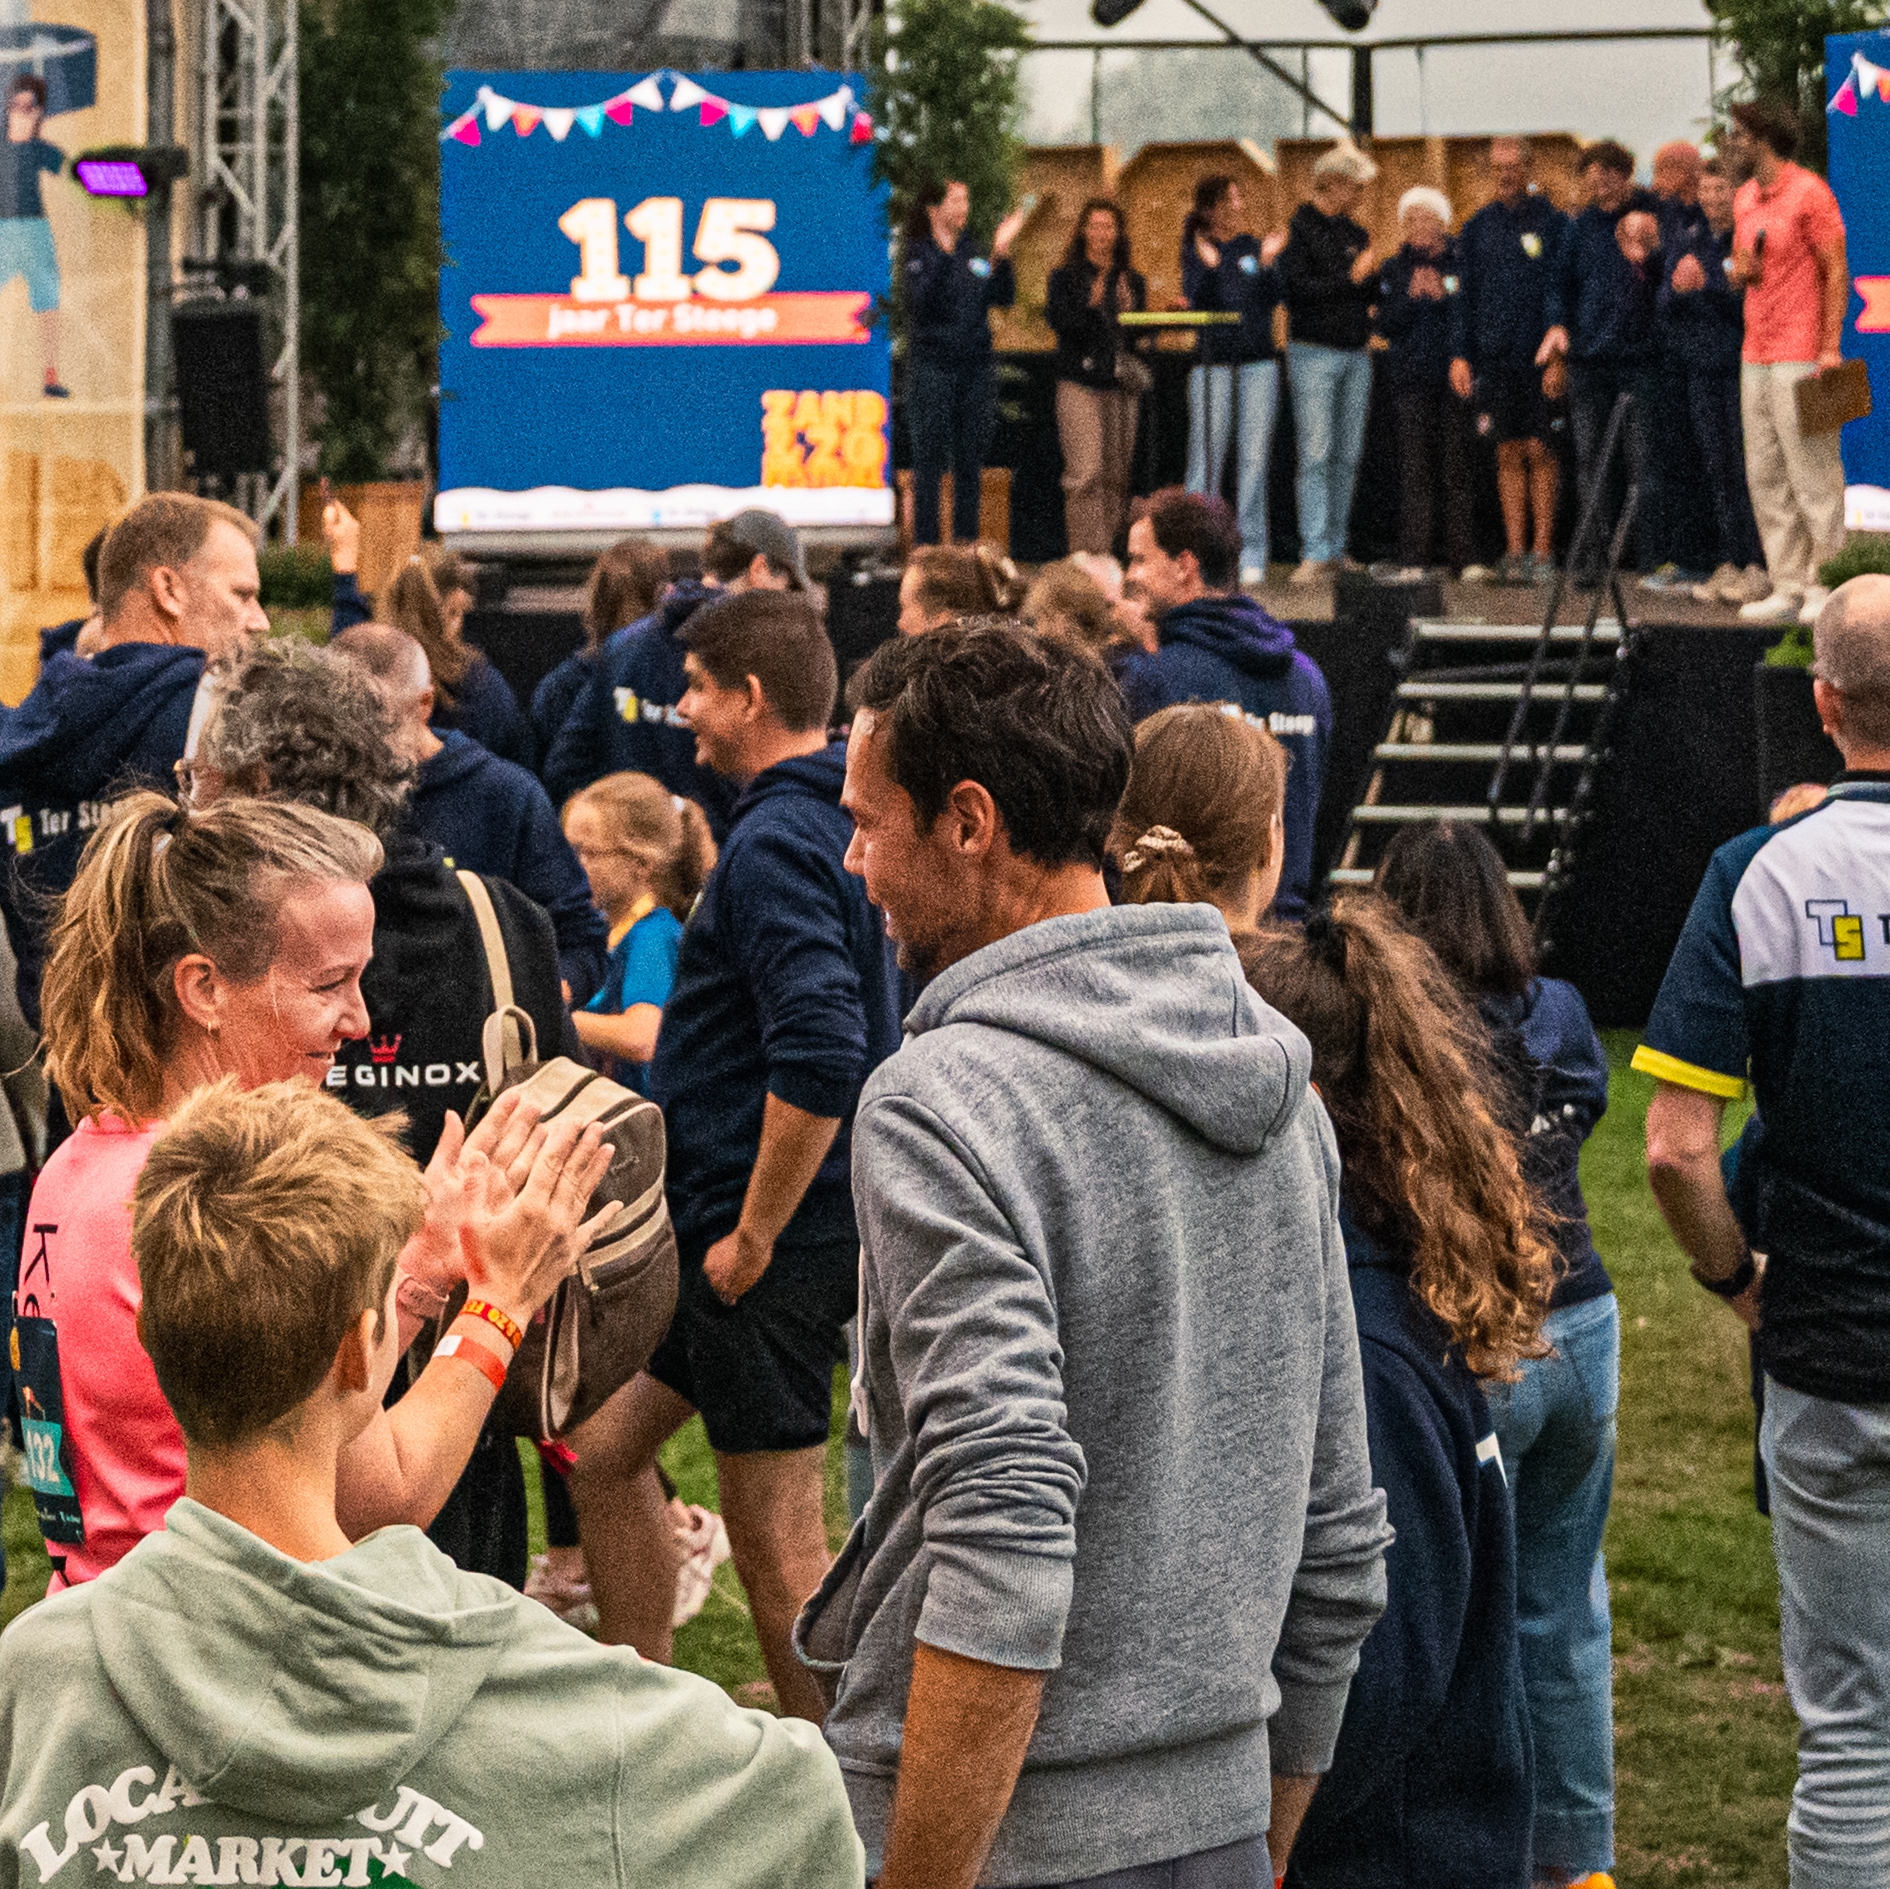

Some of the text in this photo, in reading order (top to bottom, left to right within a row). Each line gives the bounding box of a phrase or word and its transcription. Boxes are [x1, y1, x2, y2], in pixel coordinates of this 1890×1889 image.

[558, 196, 780, 302] 115
[325, 1061, 482, 1088] EGINOX
[19, 1764, 203, 1884] LOCA
[116, 1833, 383, 1888] MARKET
